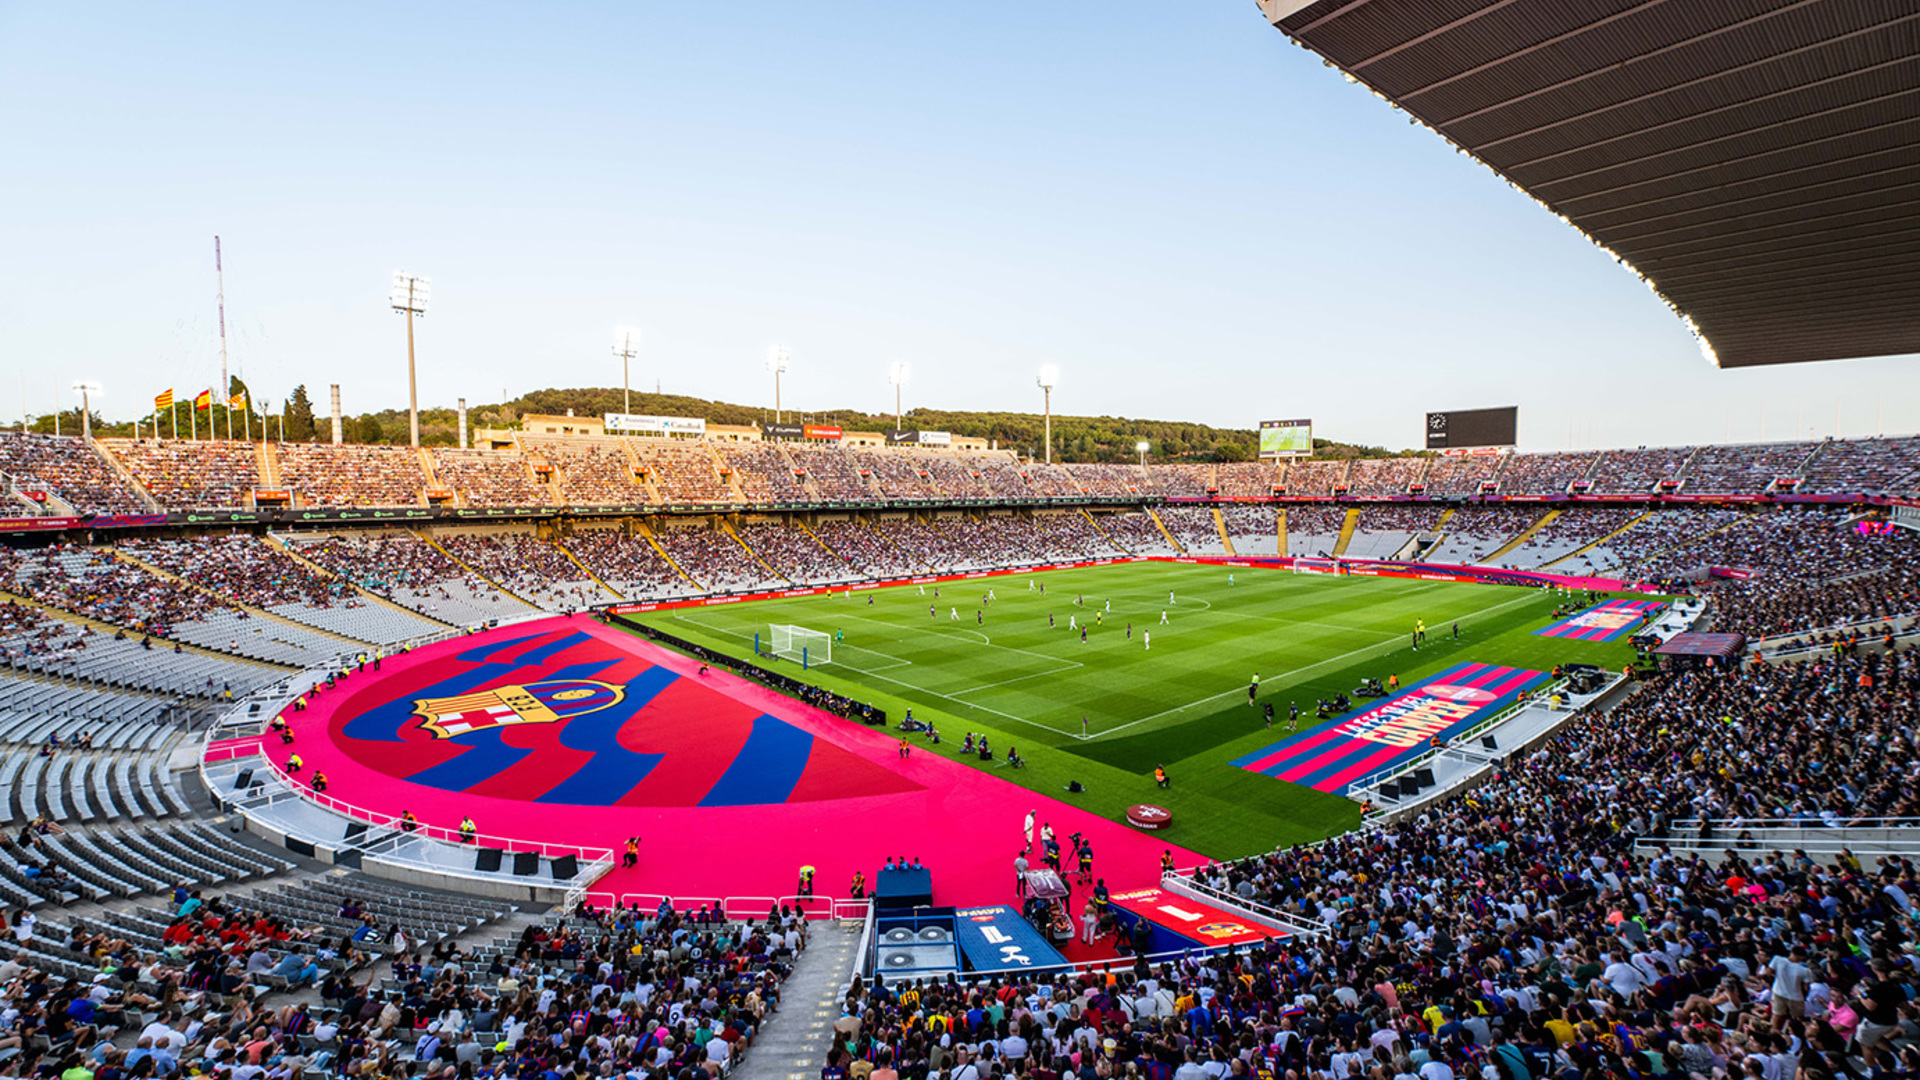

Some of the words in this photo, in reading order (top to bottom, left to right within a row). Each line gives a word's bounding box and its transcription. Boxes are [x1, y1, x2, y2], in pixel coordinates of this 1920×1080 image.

[1362, 700, 1481, 747] GAMPER
[671, 1012, 679, 1024] 9
[1628, 1034, 1646, 1049] 10
